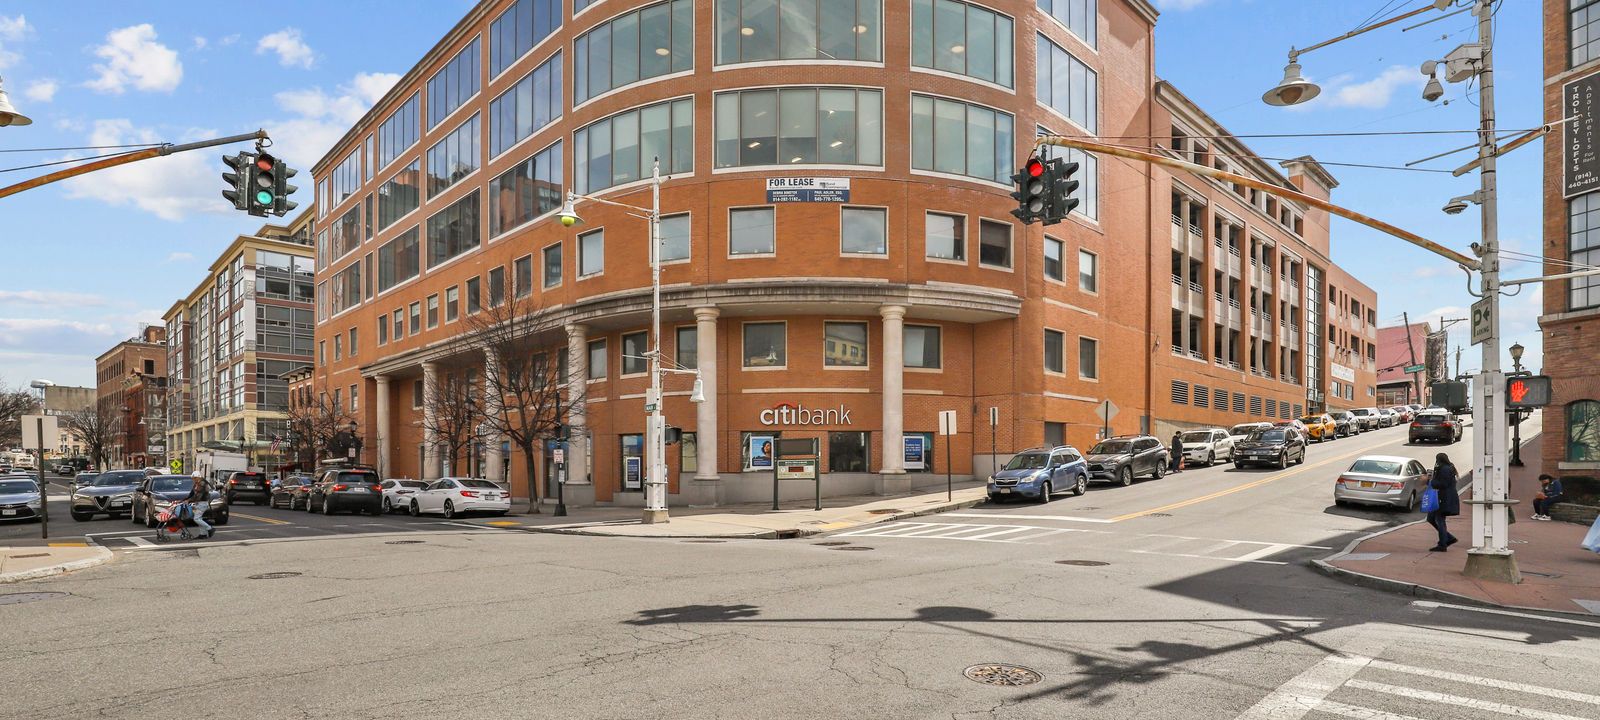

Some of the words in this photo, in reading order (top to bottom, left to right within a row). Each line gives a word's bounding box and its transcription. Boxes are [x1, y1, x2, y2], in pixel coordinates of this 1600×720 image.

[1572, 86, 1580, 134] TROLLEY
[1585, 86, 1593, 149] Apartments
[1572, 138, 1580, 171] LOFTS
[1574, 171, 1592, 181] (914)
[760, 402, 852, 425] citibank
